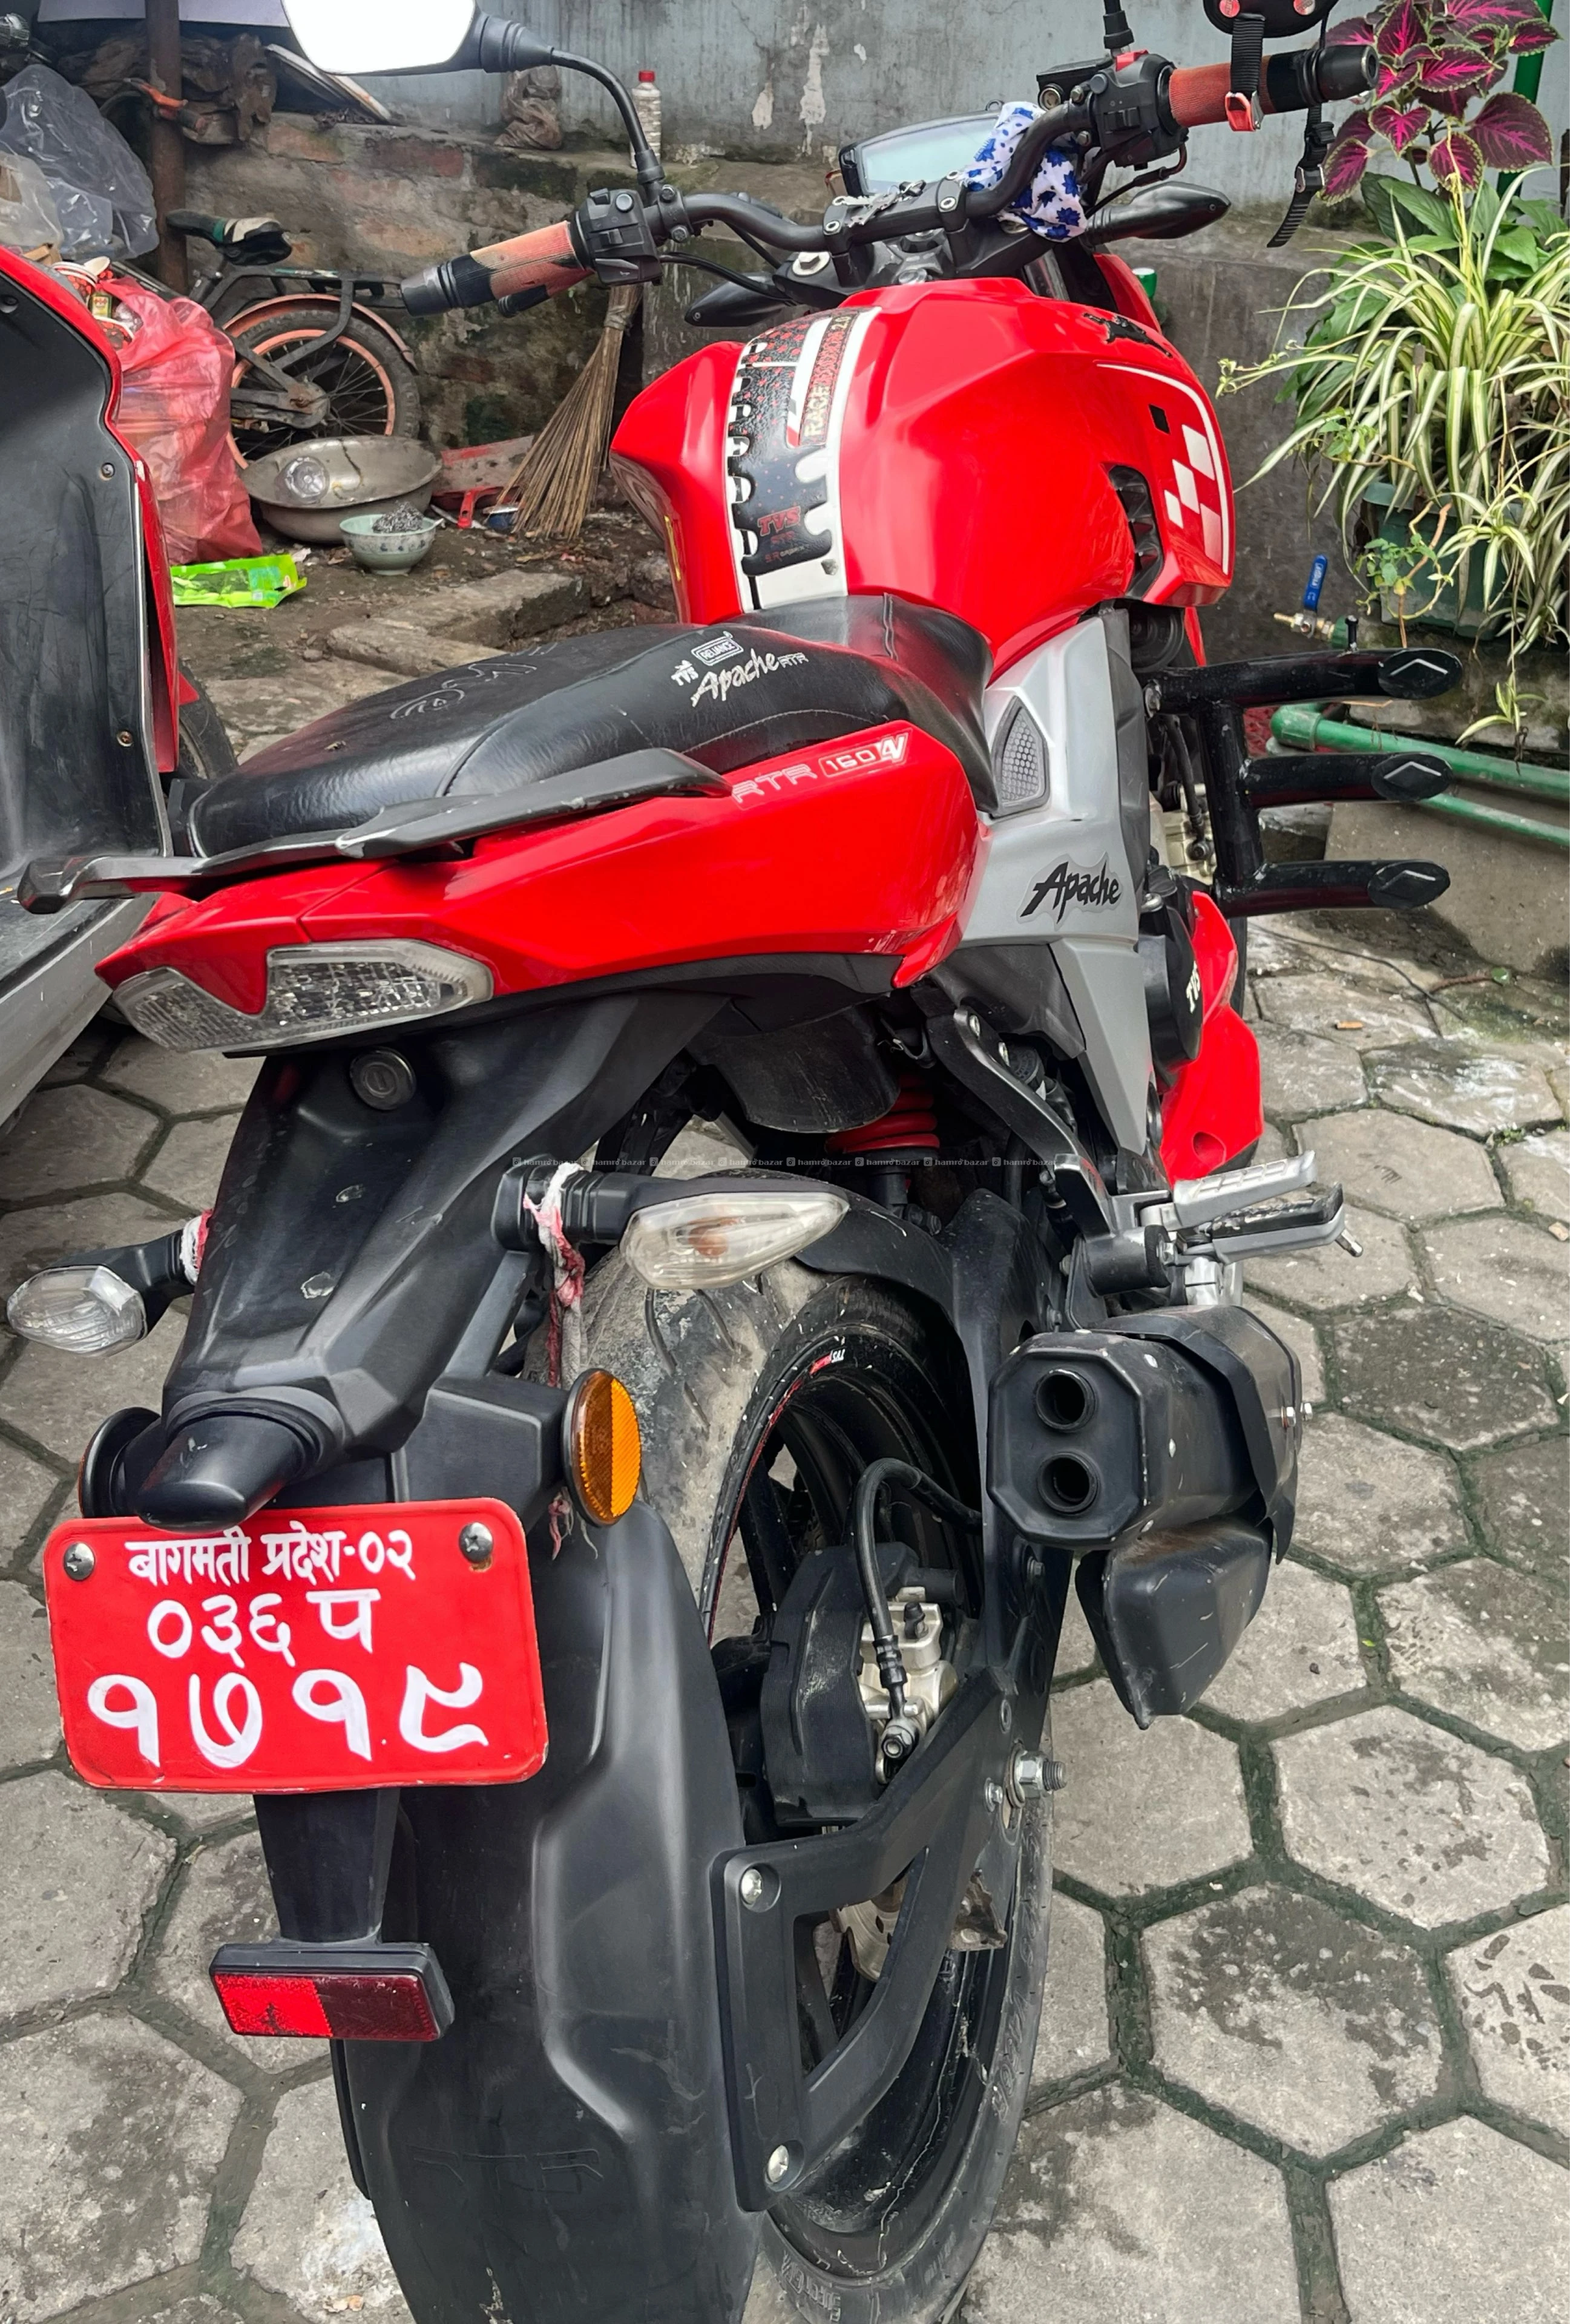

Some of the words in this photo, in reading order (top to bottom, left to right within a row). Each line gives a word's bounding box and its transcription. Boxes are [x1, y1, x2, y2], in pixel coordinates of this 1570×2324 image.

[758, 506, 801, 537] TVS
[671, 665, 699, 686] TVS
[690, 648, 780, 707] Apache
[731, 763, 818, 804] RTR
[1020, 861, 1121, 924] Apache
[124, 1525, 252, 1587] बागमती
[146, 1592, 296, 1668] ०३६
[305, 1588, 381, 1654] प
